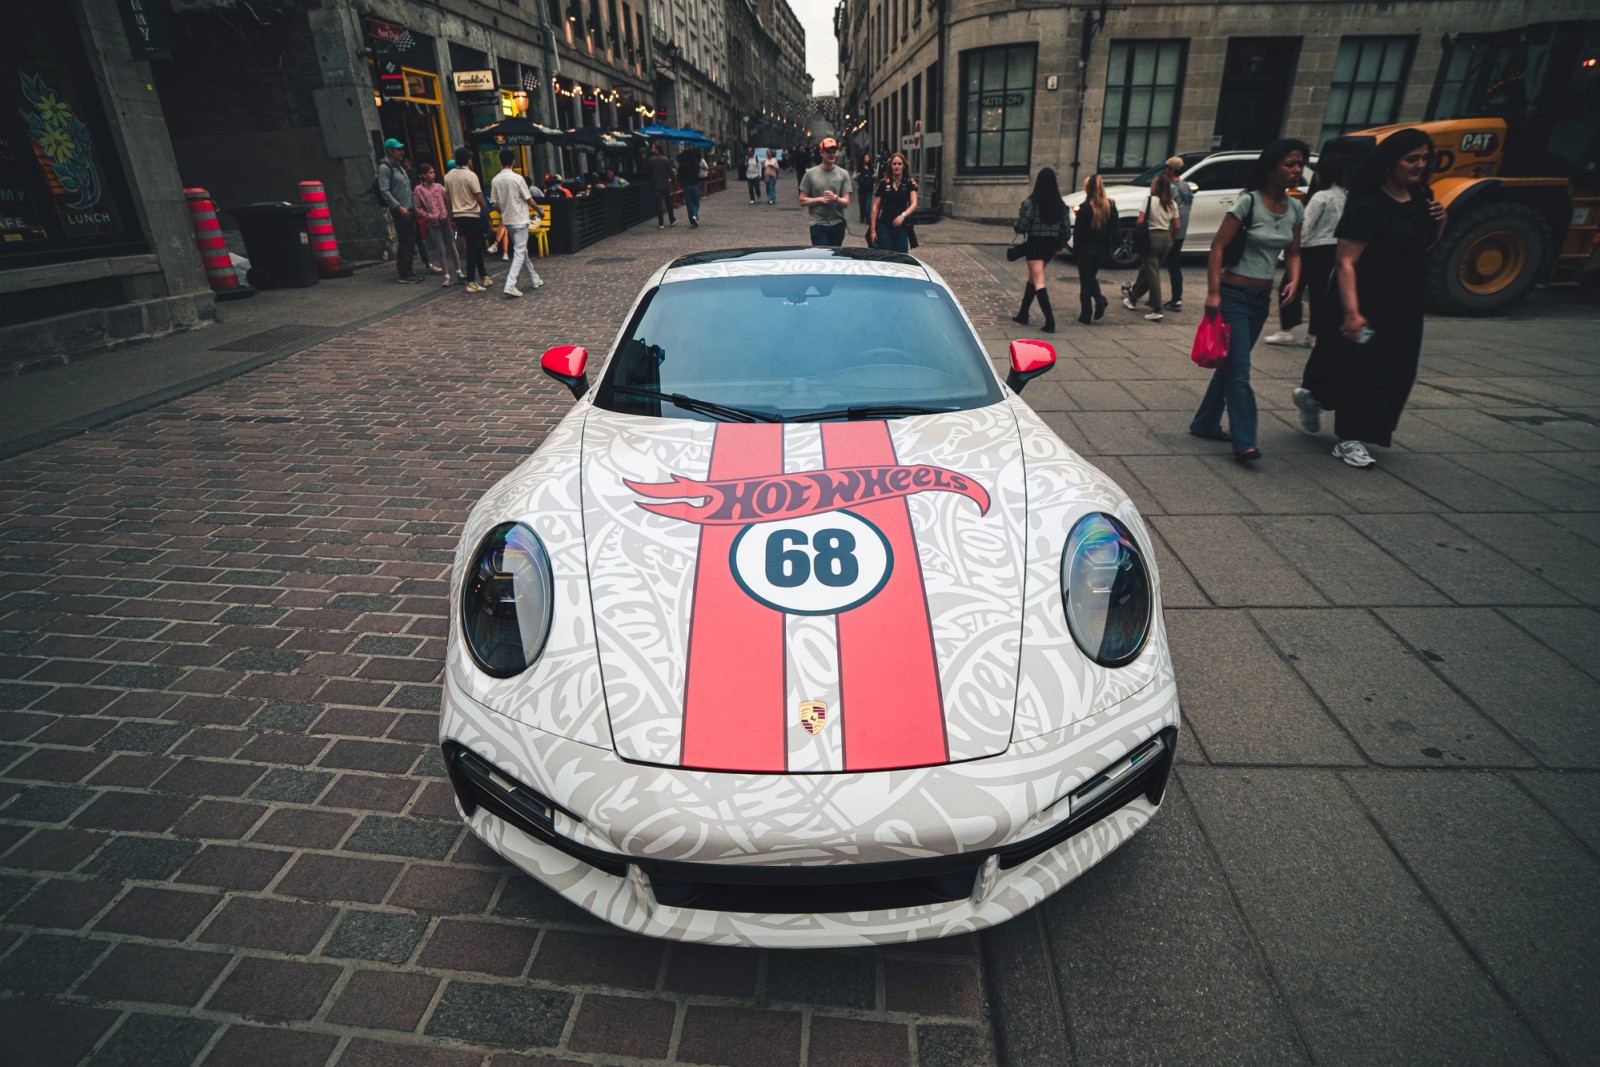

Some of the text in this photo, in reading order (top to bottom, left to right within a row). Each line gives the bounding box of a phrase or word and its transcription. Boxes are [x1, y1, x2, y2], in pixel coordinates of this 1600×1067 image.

[457, 74, 490, 87] franklin's
[981, 95, 1022, 106] PATTION
[1461, 133, 1492, 152] CAT
[67, 211, 111, 225] LUNCH
[765, 528, 859, 588] 68
